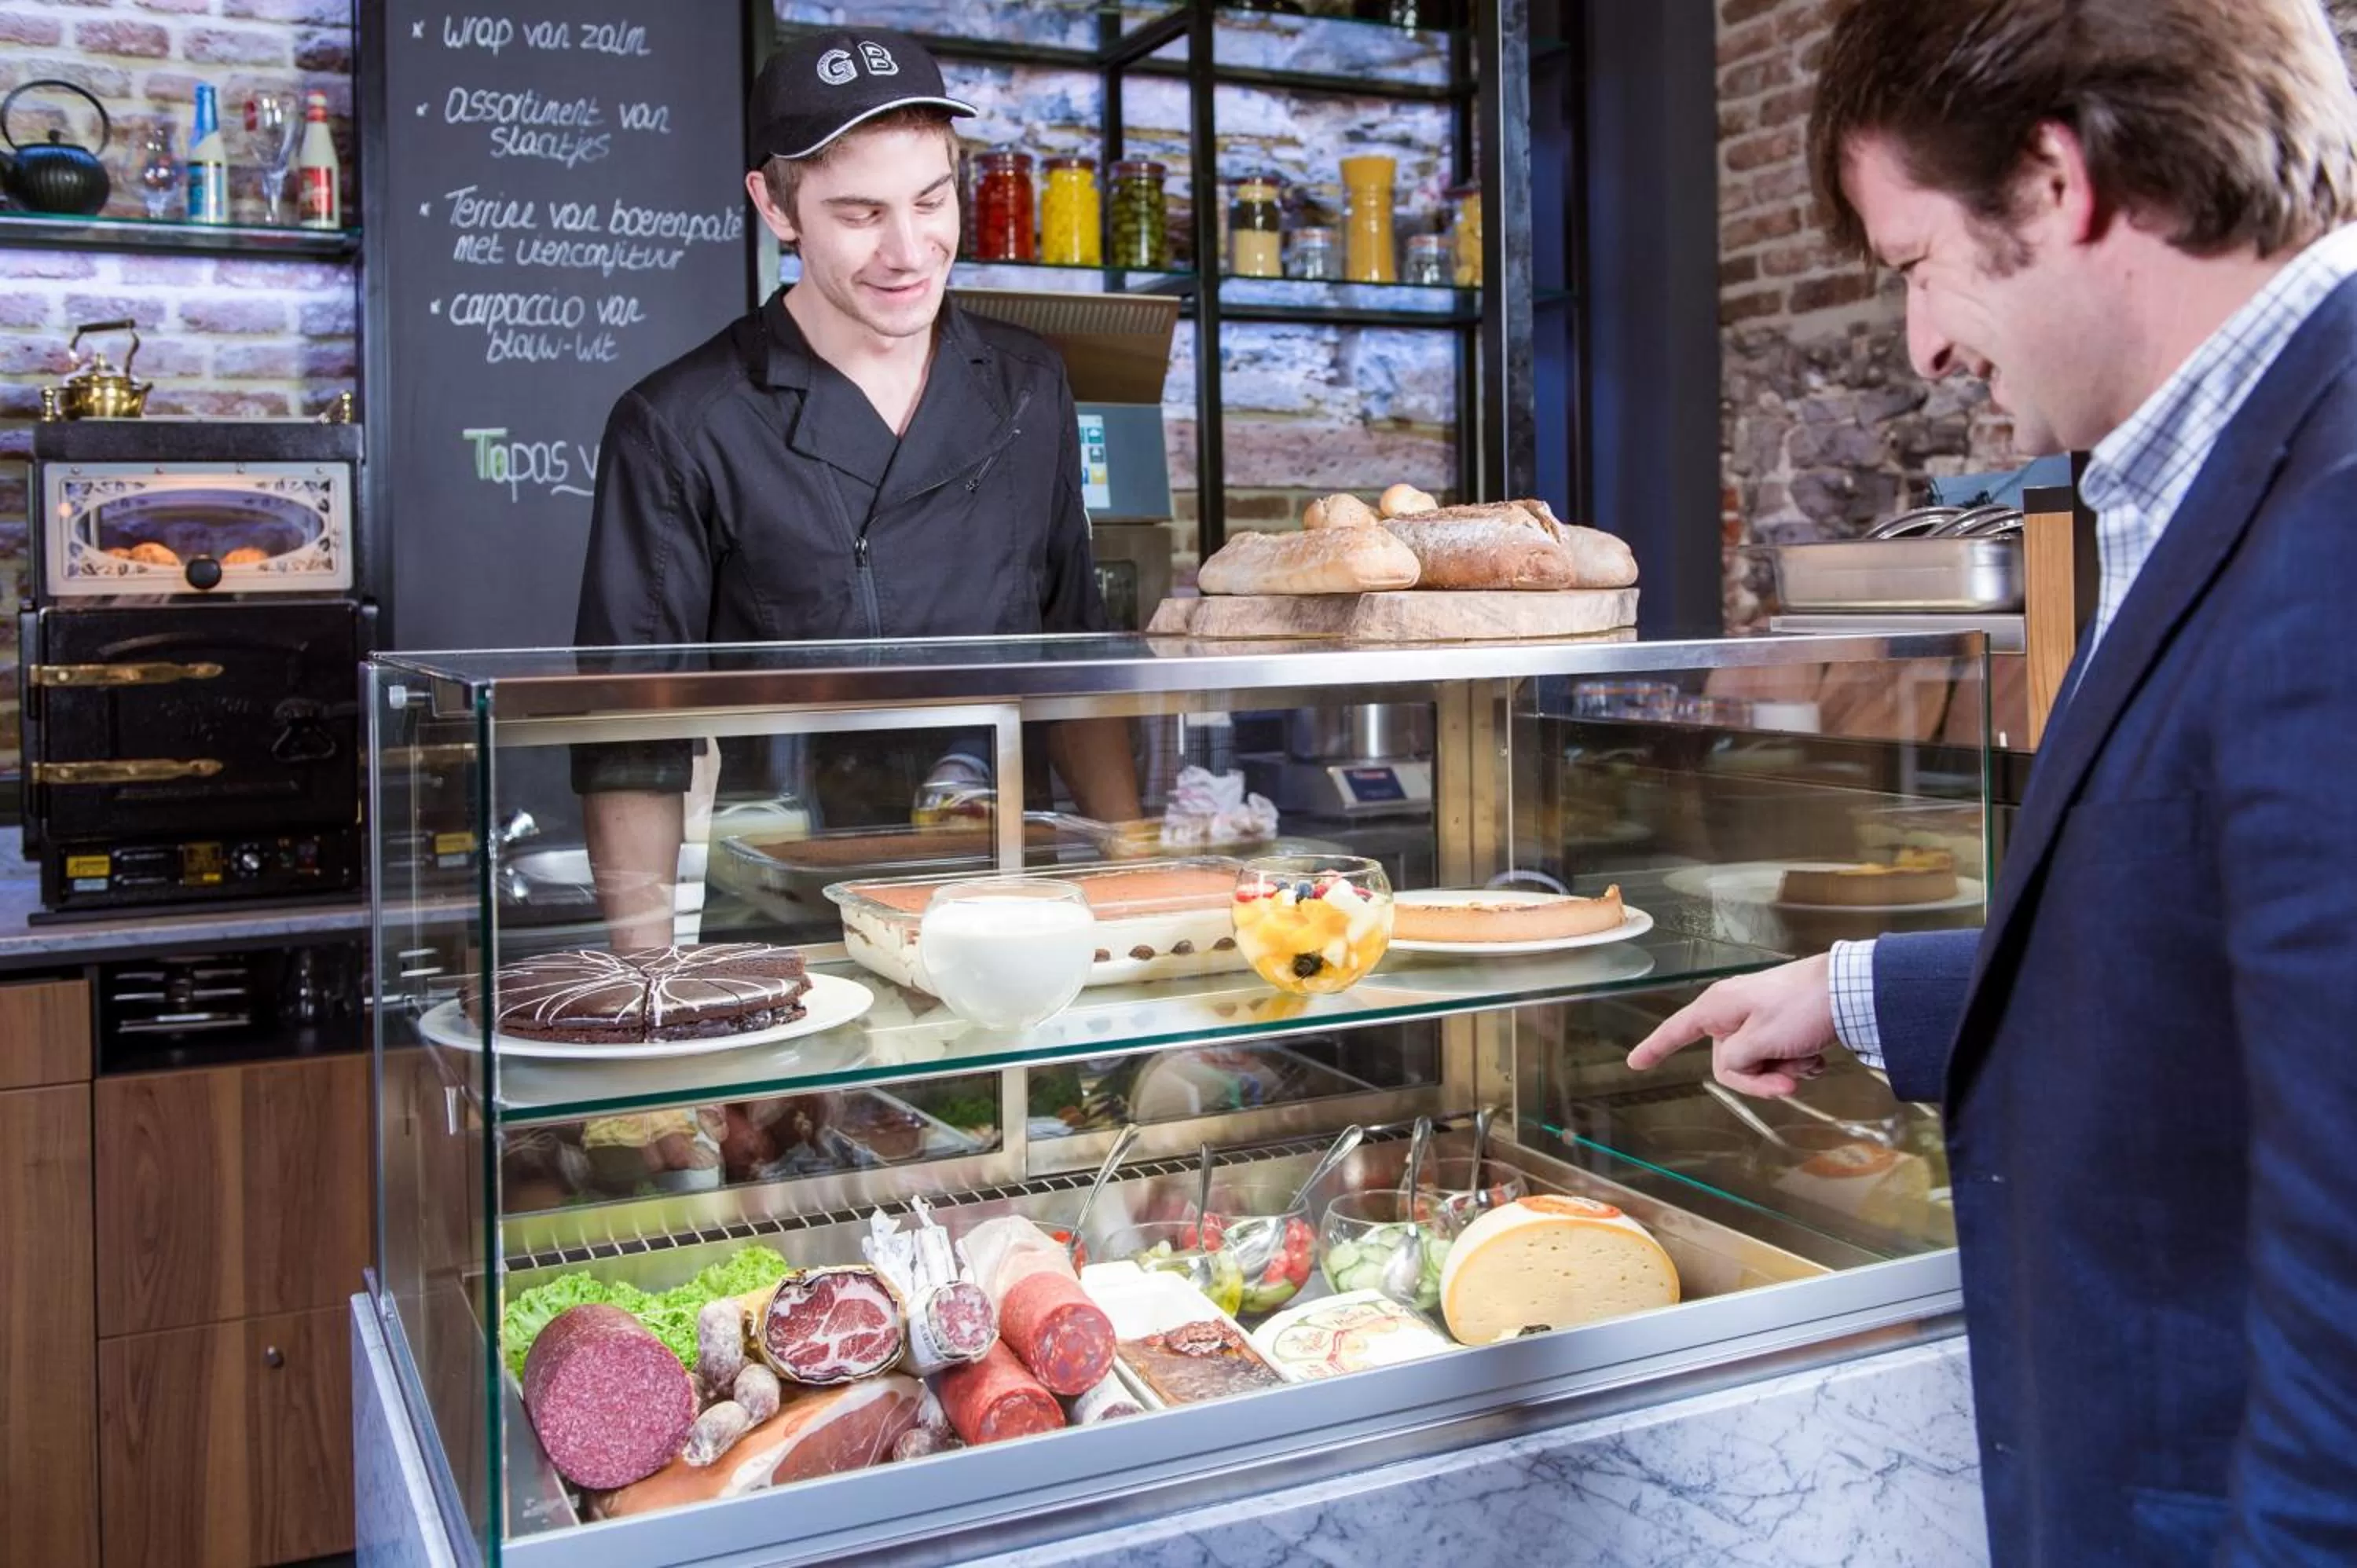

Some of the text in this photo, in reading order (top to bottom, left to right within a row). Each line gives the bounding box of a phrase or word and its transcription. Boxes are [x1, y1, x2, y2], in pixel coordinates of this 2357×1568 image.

[522, 22, 570, 50] van
[580, 20, 651, 57] zalm
[618, 101, 672, 134] van
[549, 200, 601, 233] van
[596, 295, 647, 328] van
[462, 427, 569, 504] Tapas
